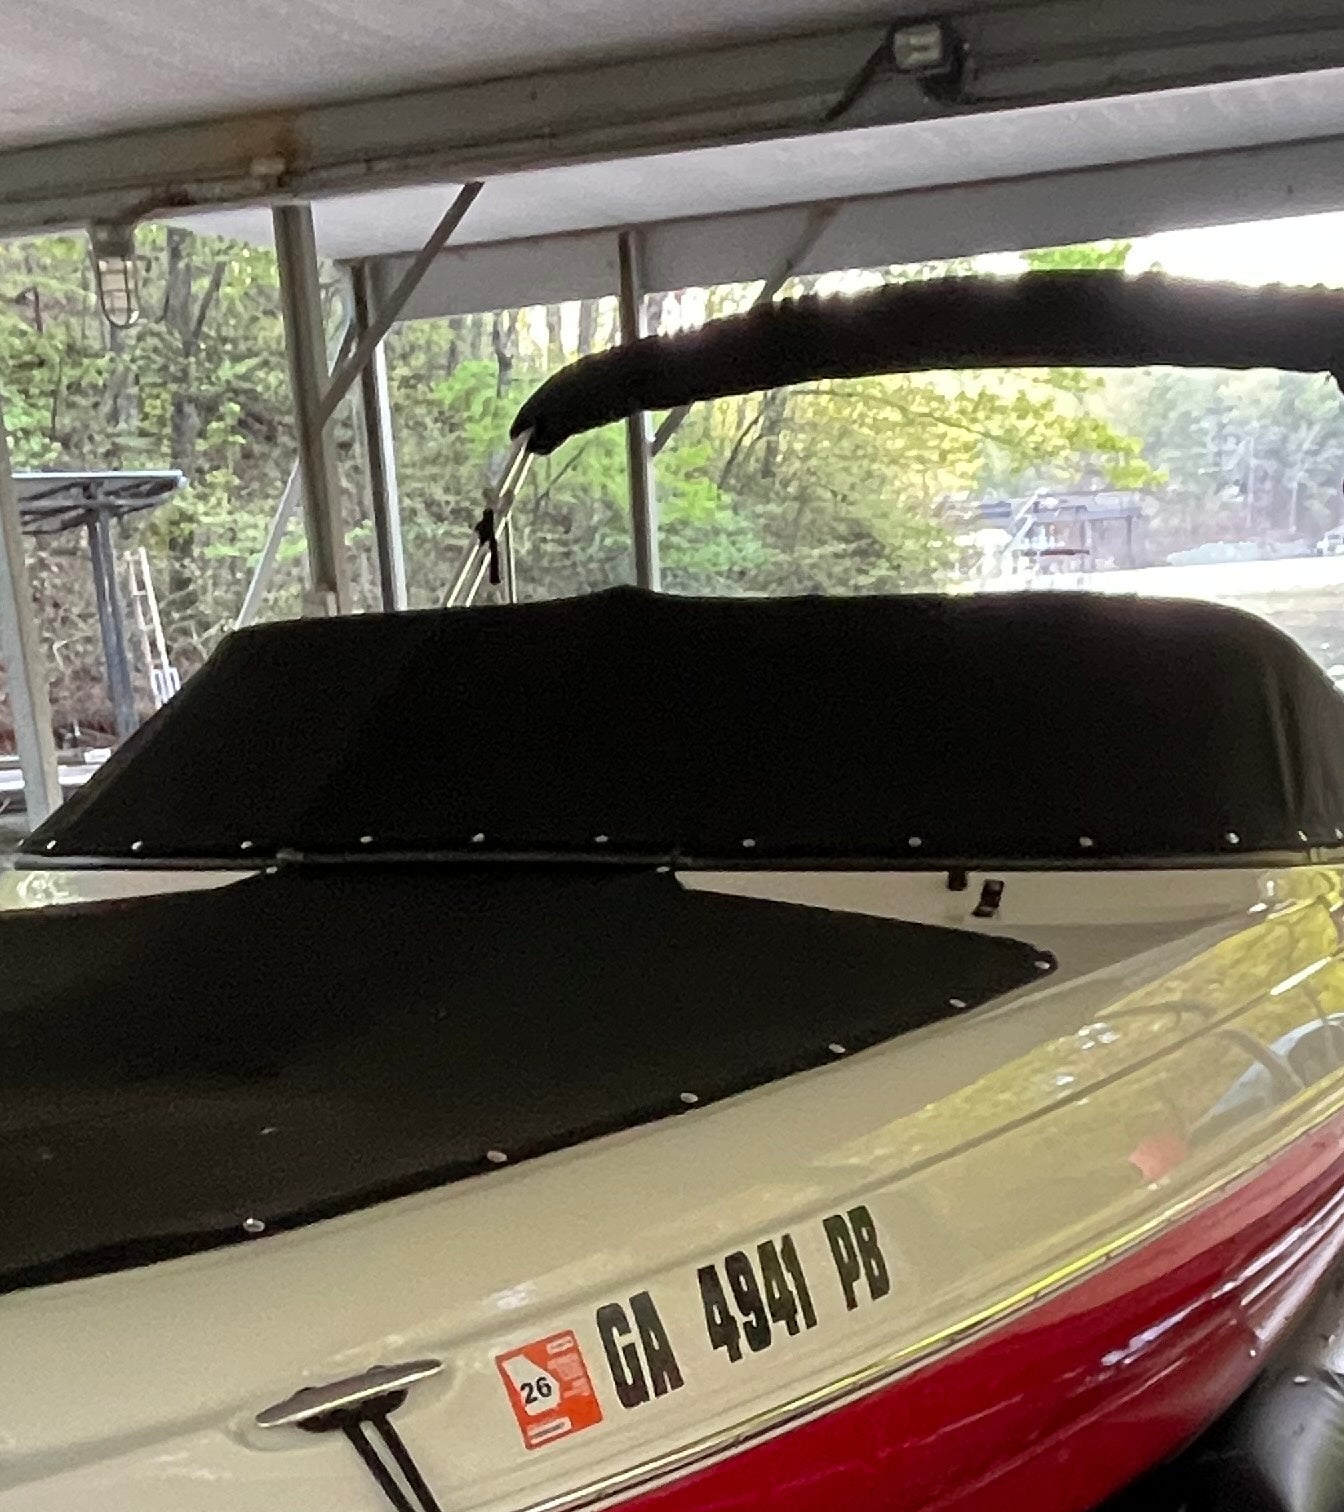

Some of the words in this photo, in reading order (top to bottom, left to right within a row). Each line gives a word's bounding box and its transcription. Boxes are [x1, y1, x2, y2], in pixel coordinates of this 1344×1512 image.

[596, 1291, 684, 1409] GA
[697, 1233, 817, 1363] 4941
[823, 1206, 889, 1311] PB
[520, 1377, 552, 1404] 26
